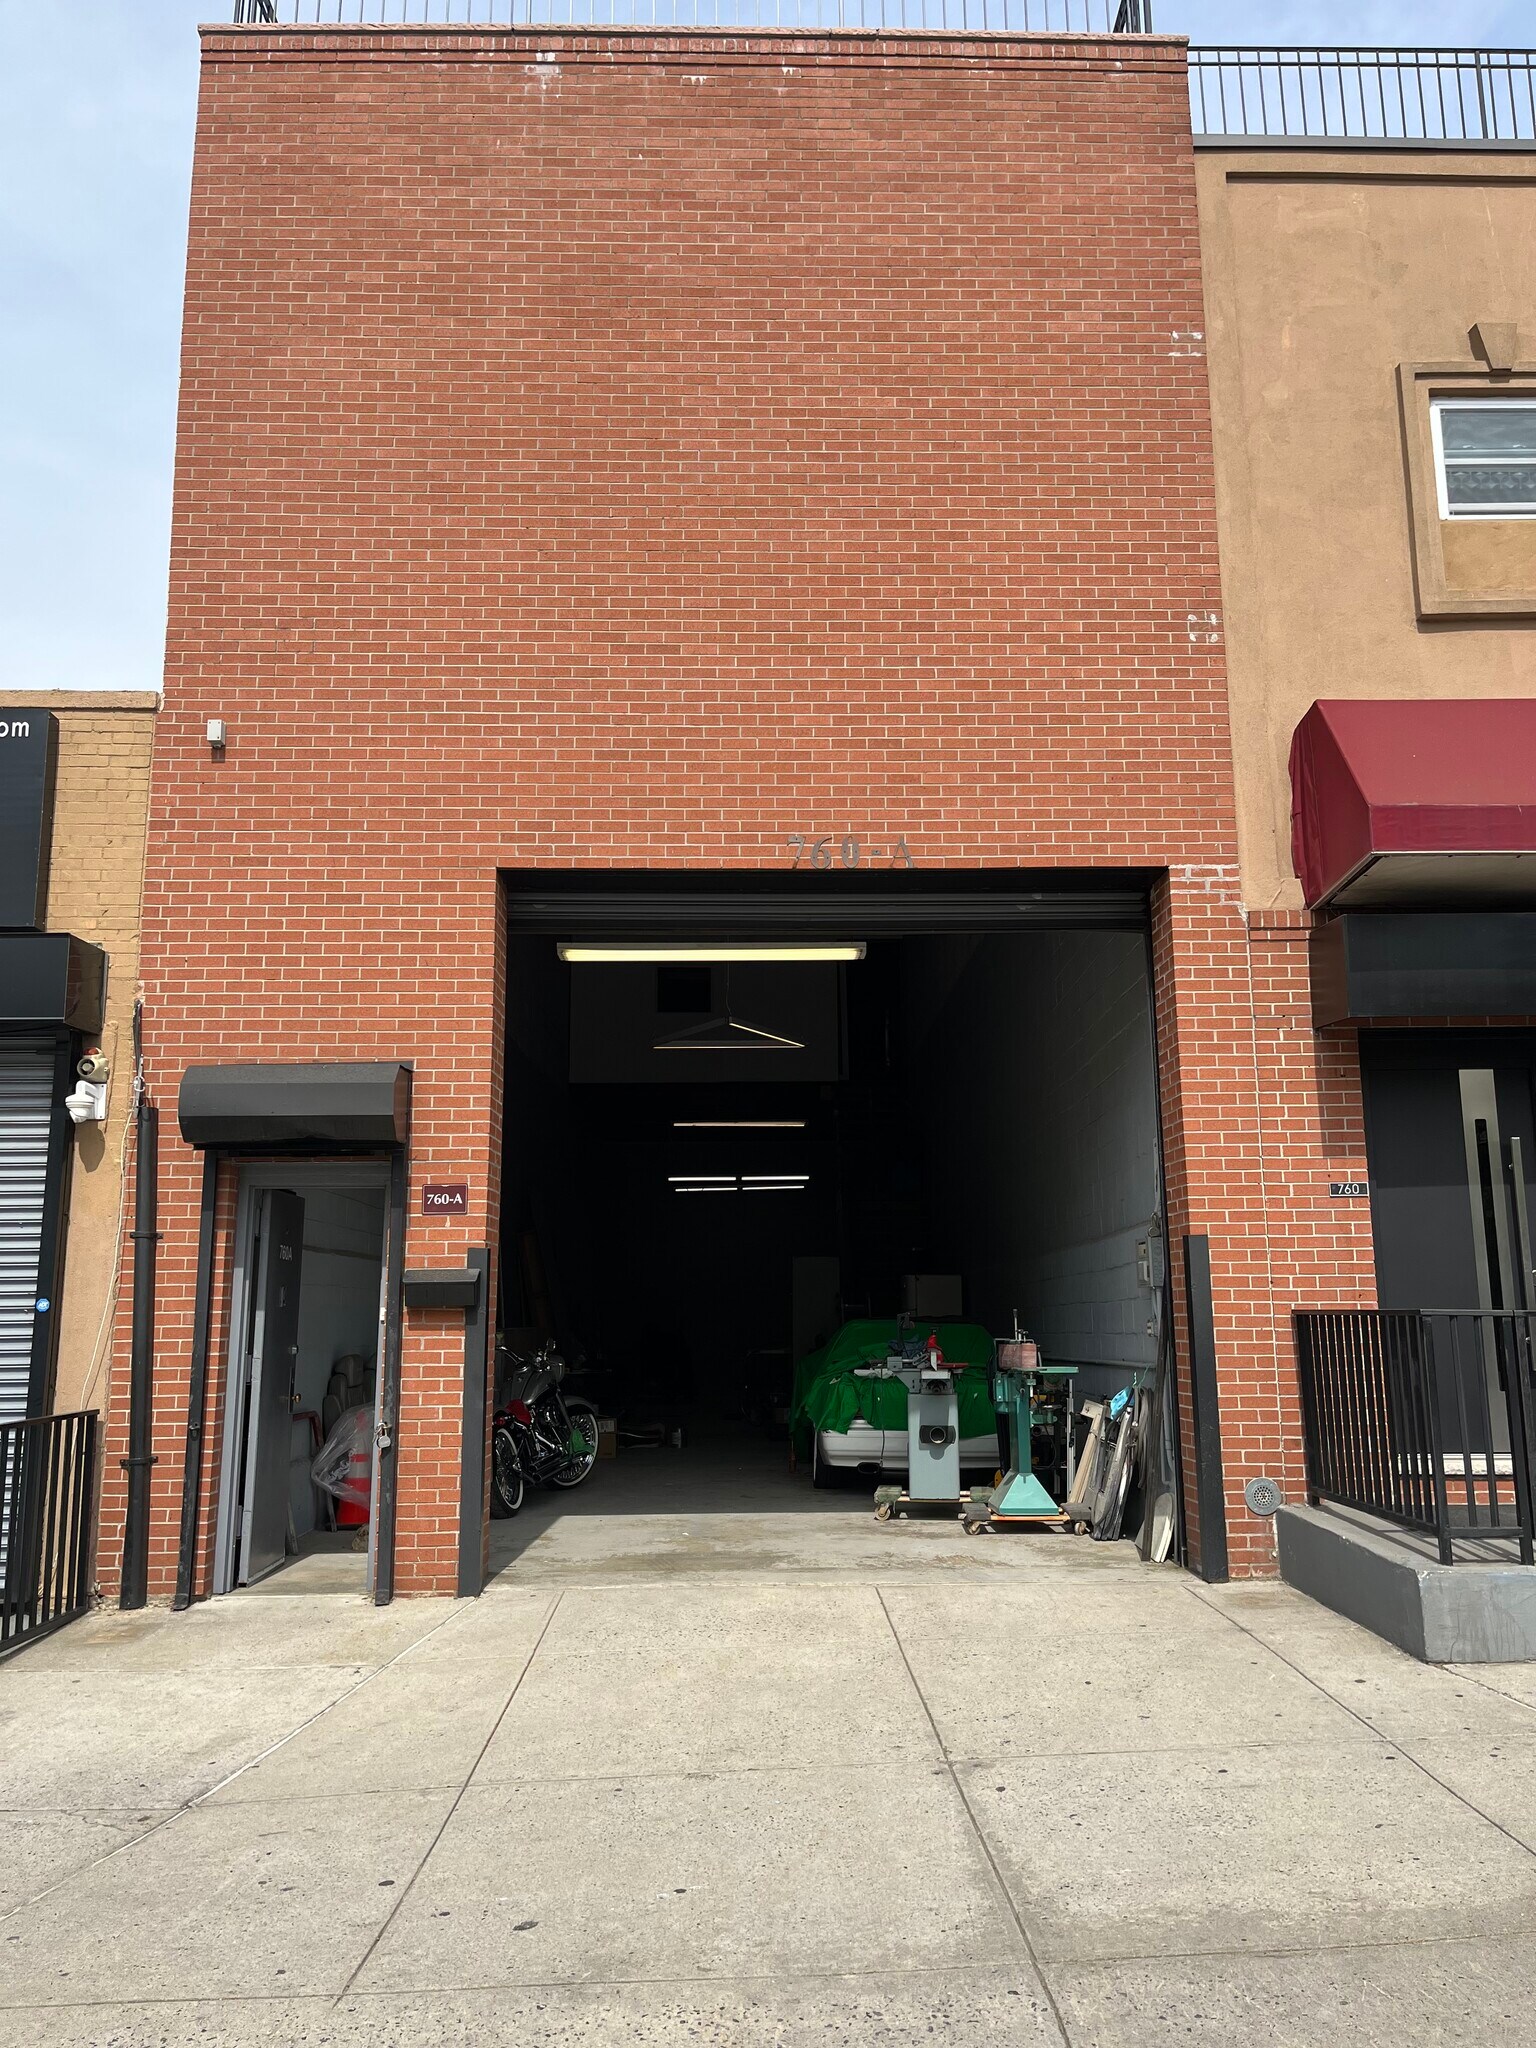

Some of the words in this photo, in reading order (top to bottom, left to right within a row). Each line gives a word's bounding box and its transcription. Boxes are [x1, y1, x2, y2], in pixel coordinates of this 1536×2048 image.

[786, 835, 918, 869] 760-A
[1337, 1183, 1360, 1195] 760
[426, 1193, 463, 1205] 760-A
